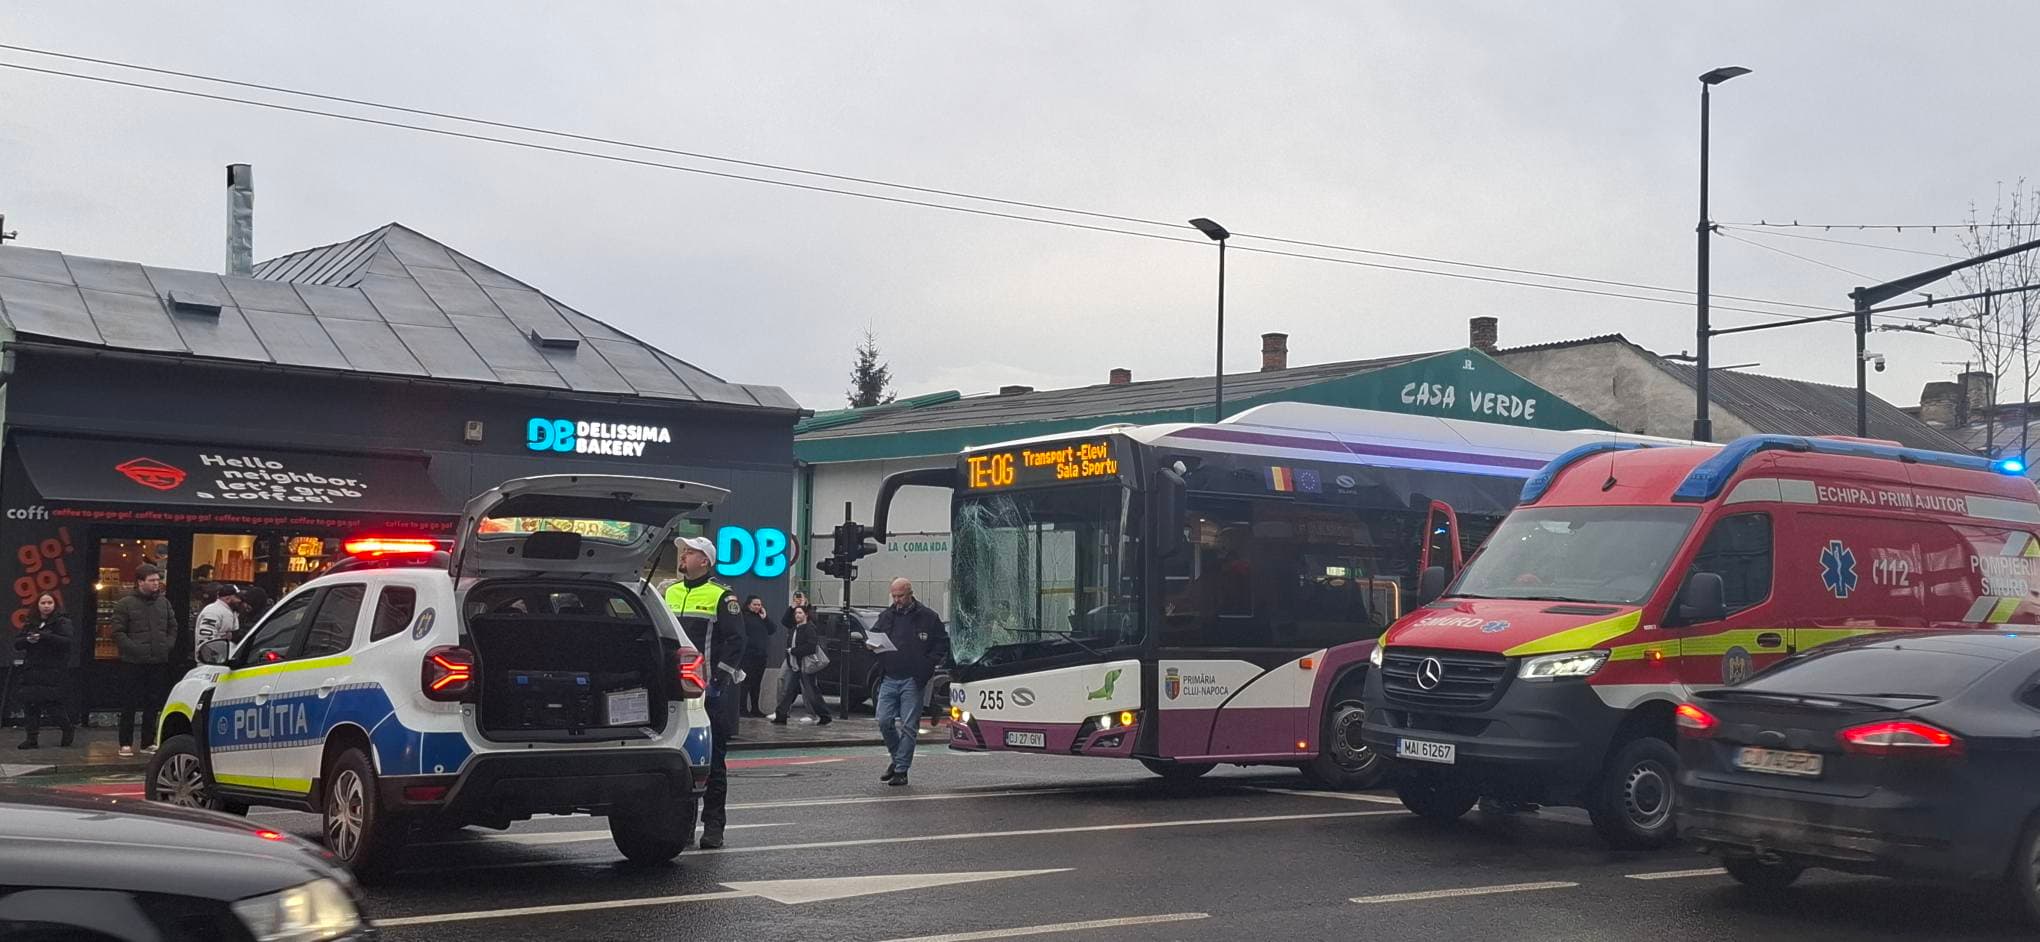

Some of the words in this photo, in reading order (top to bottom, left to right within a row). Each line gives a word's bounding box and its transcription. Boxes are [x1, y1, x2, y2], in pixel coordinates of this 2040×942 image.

[1401, 382, 1455, 409] CASA
[1470, 390, 1536, 420] VERDE
[527, 417, 575, 452] DB
[577, 421, 671, 443] DELISSIMA
[576, 438, 646, 457] BAKERY
[1023, 446, 1073, 467] Transport
[200, 454, 283, 469] Hello
[1056, 463, 1079, 480] Sala
[1082, 458, 1117, 477] Sportu
[215, 480, 287, 493] let's
[293, 486, 362, 498] grab
[223, 470, 368, 489] neighbor,
[196, 491, 215, 499] a
[222, 491, 334, 504] coffee!
[1817, 485, 1876, 505] ECHIPAJ
[1879, 491, 1913, 508] PRIM
[1915, 494, 1967, 513] AJUTOR
[17, 526, 74, 573] go!
[716, 525, 786, 577] DB
[888, 542, 898, 552] LA
[903, 541, 947, 552] COMANDA
[15, 558, 71, 606] go!
[1880, 559, 1909, 587] 112
[1981, 577, 2028, 597] SMURD
[1413, 616, 1483, 628] SMURD
[980, 690, 1004, 710] 255
[1183, 685, 1229, 697] CLUJ-NAPOCA
[1019, 733, 1028, 744] 27
[1404, 740, 1419, 755] MAI
[1422, 743, 1451, 760] 61267
